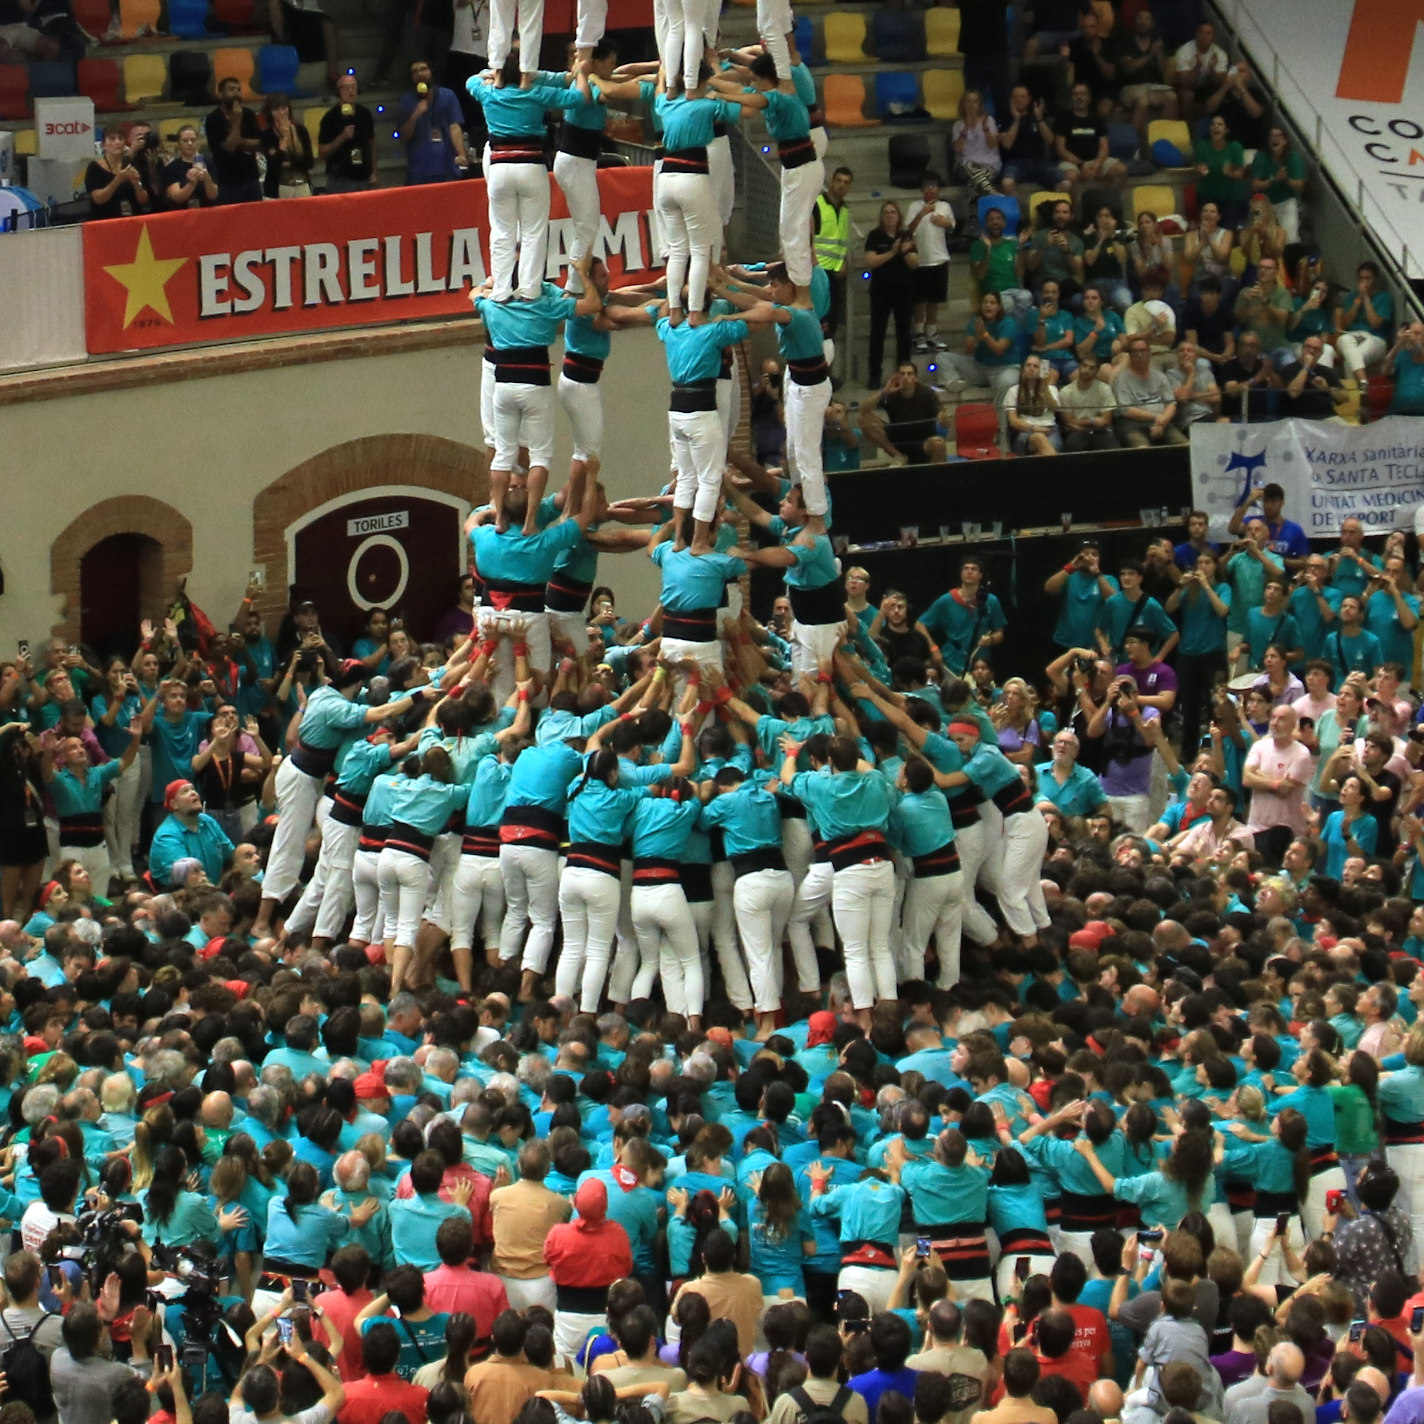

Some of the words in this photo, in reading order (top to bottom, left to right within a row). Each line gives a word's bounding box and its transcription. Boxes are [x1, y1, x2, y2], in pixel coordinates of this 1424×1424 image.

[197, 227, 487, 322] ESTRELLA
[1305, 446, 1357, 465] XARXA
[1326, 468, 1379, 484] SANTA
[352, 513, 403, 535] TORILES
[1312, 512, 1333, 526] DE
